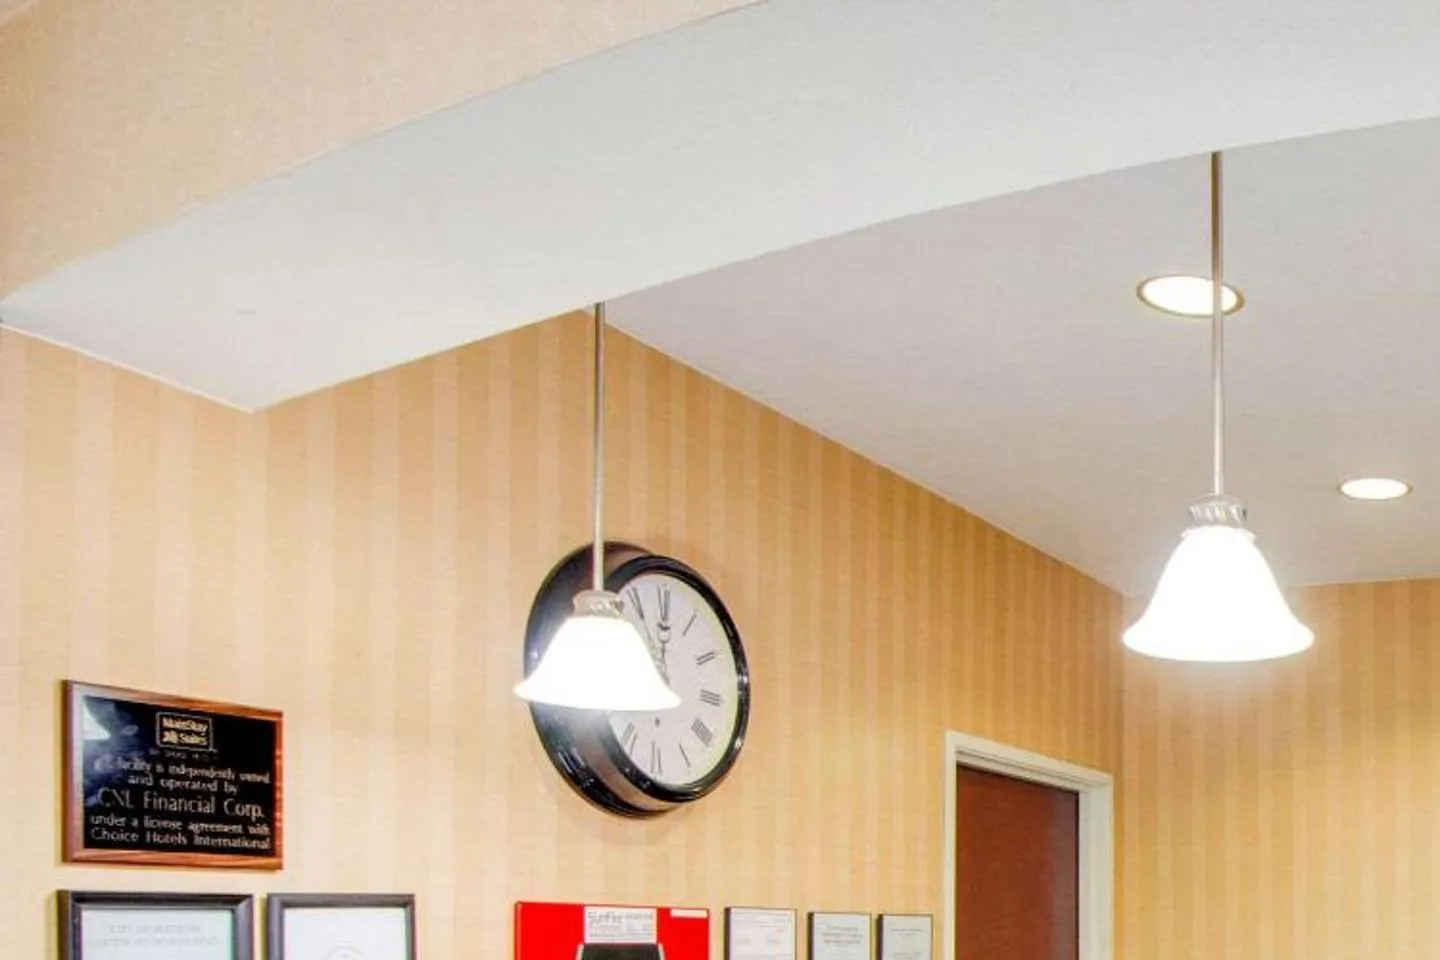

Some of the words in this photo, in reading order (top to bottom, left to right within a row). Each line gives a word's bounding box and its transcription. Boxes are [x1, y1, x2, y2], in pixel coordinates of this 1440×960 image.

[127, 773, 154, 787] and
[160, 777, 218, 792] operated
[223, 780, 239, 795] by
[168, 763, 236, 781] independently
[239, 771, 271, 785] owned
[98, 786, 135, 809] CNL
[143, 789, 216, 815] Financial
[223, 797, 265, 822] Corp.
[91, 813, 127, 827] under
[144, 814, 183, 830] license
[187, 821, 243, 834] agreement
[247, 823, 270, 836] with
[91, 827, 139, 841] Choice
[145, 830, 188, 846] Hotels
[192, 834, 271, 850] International
